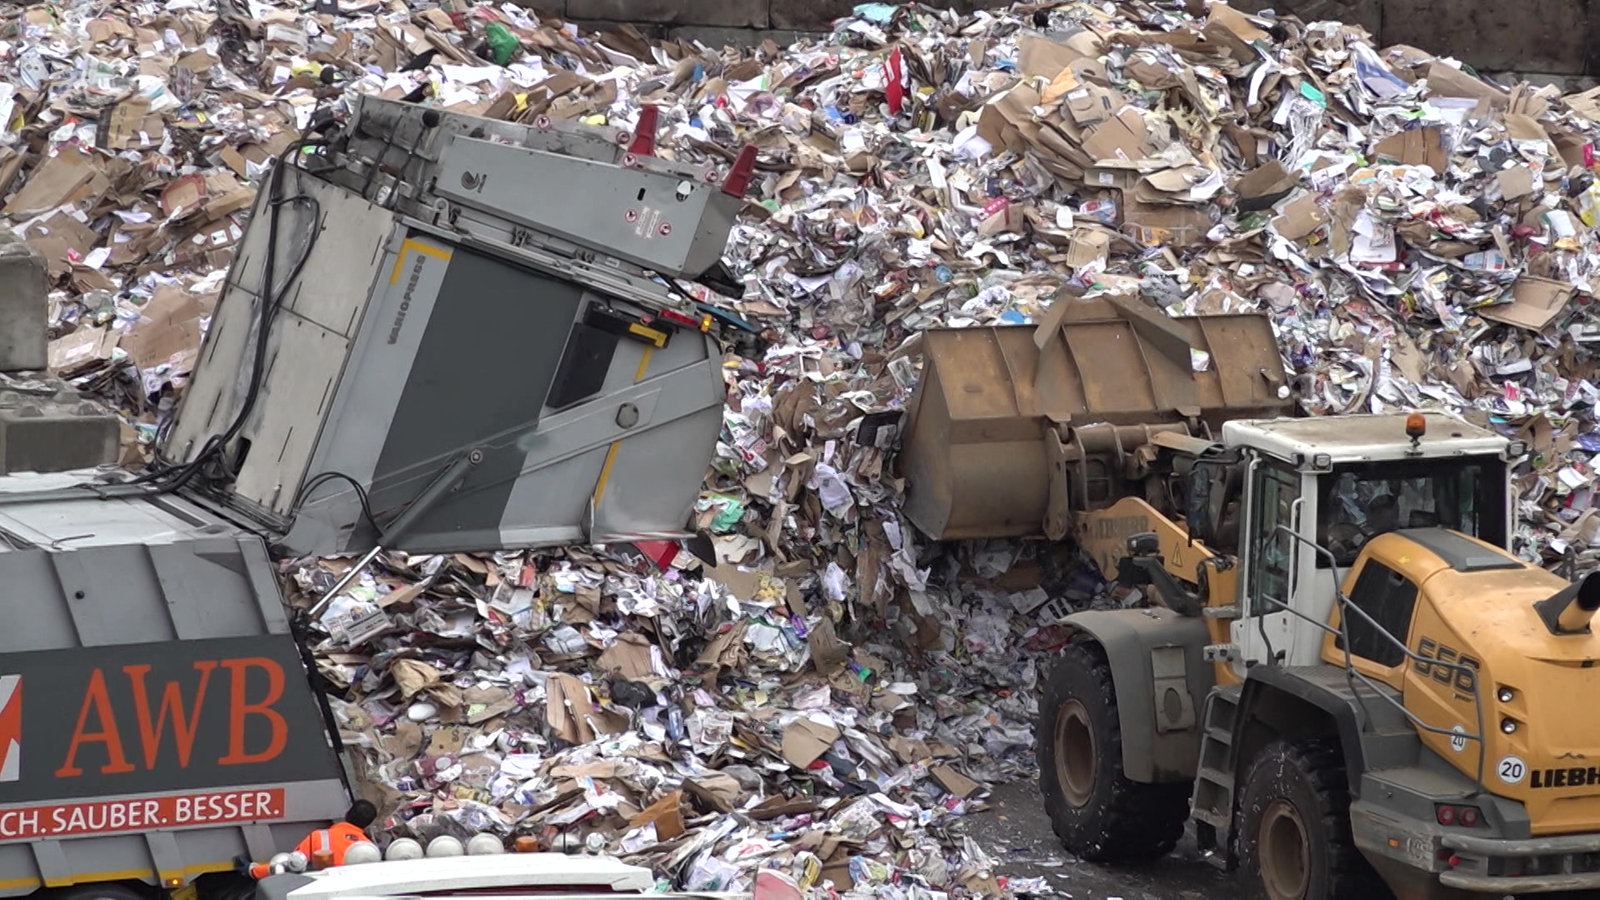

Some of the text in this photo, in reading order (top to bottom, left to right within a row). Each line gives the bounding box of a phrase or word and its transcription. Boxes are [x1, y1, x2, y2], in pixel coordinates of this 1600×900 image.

[387, 255, 427, 345] VARIOPRESS
[56, 657, 288, 778] AWB
[1501, 761, 1523, 779] 20
[1530, 767, 1600, 788] LIEBH
[52, 801, 167, 833] SAUBER.
[175, 795, 279, 822] BESSER.
